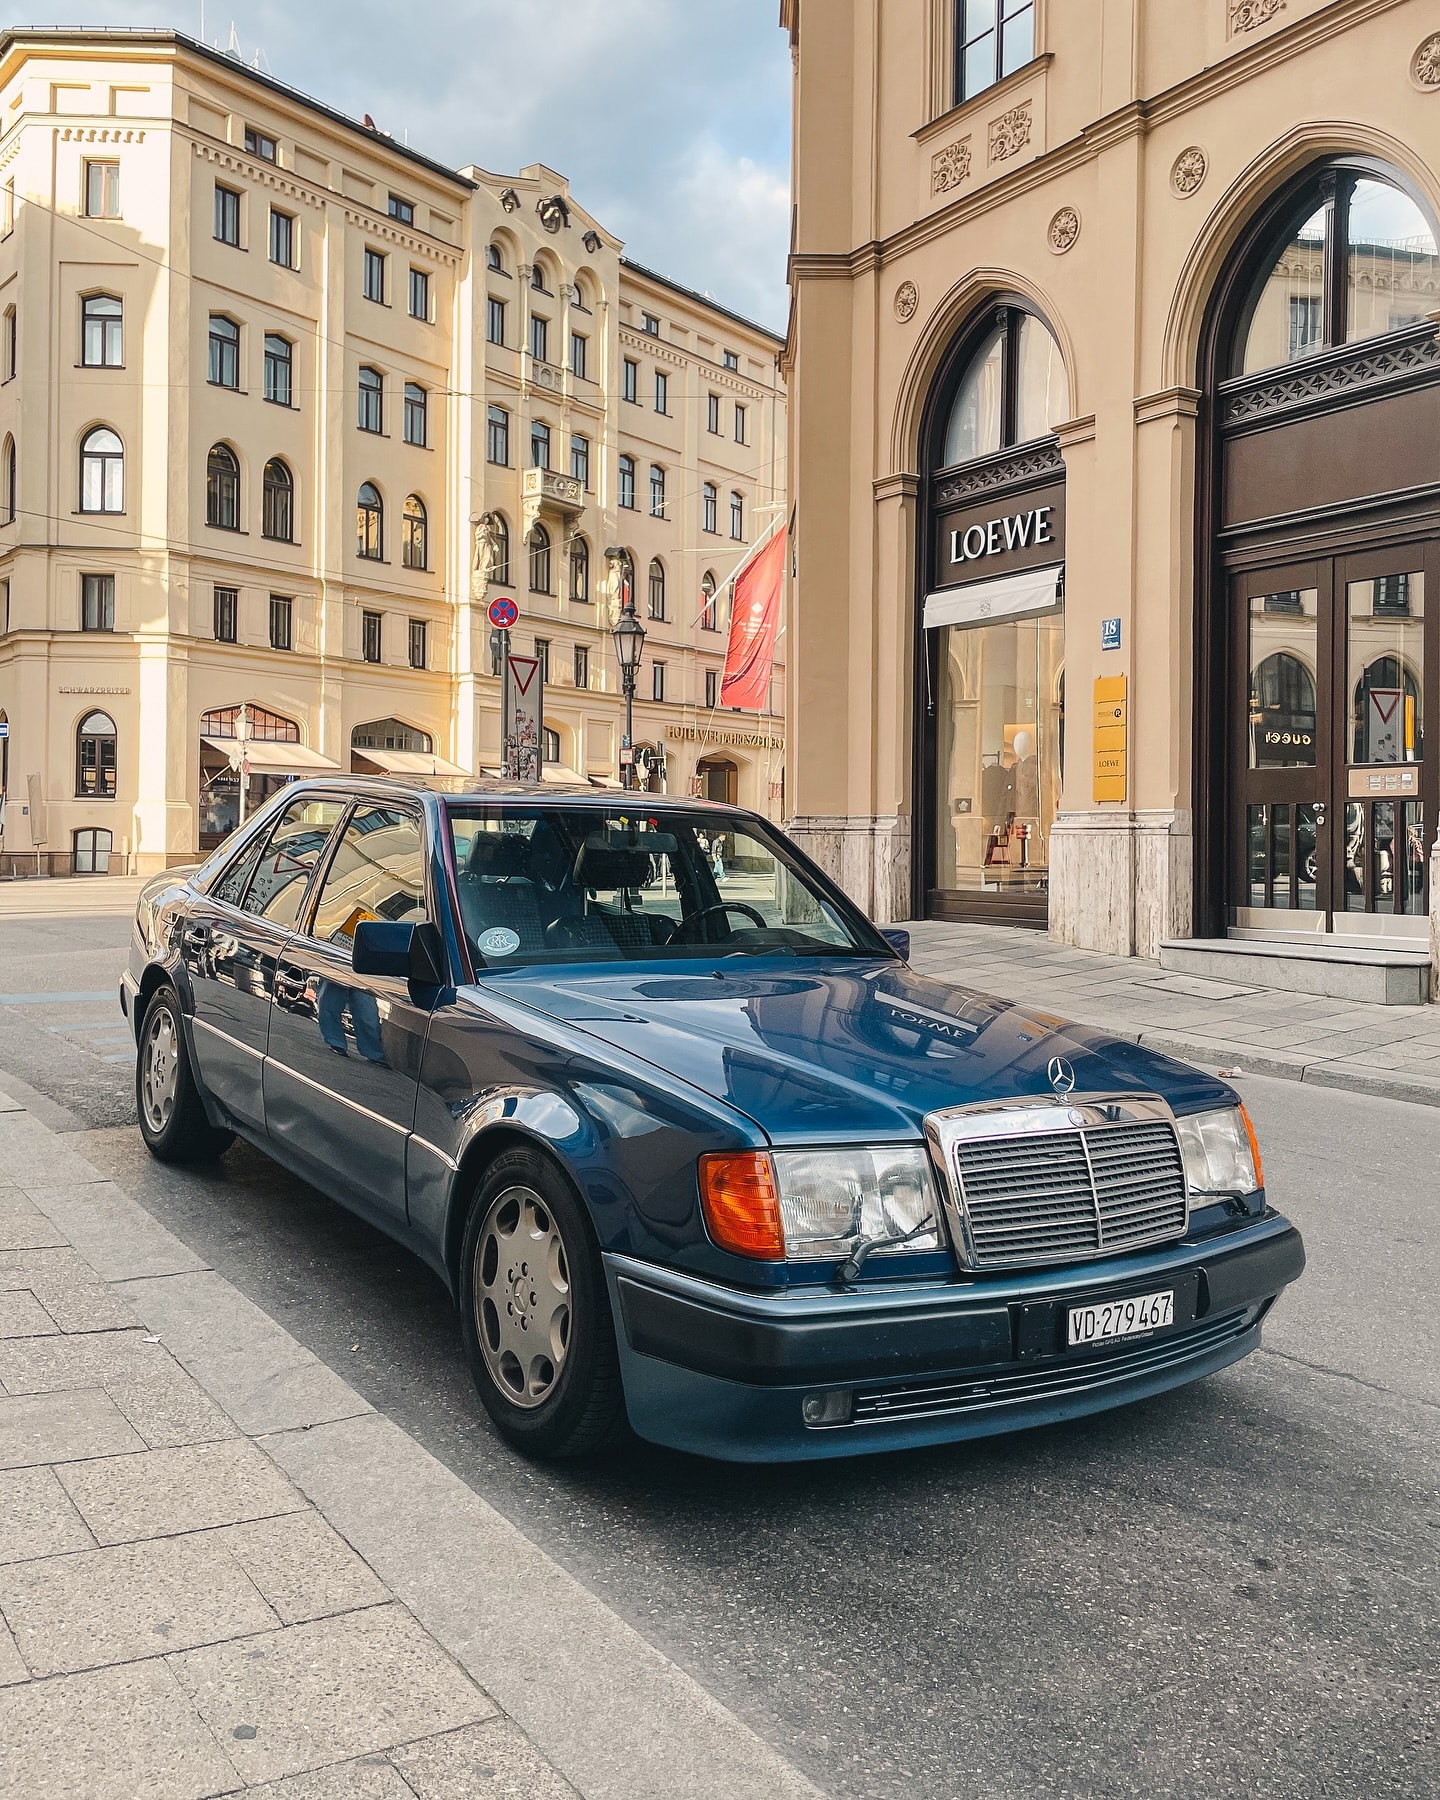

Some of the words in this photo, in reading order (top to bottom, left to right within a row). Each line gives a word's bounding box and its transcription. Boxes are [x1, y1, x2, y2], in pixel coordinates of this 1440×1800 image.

[950, 506, 1052, 564] LOEWE
[1104, 620, 1117, 636] 18
[1098, 760, 1121, 768] LOEWE
